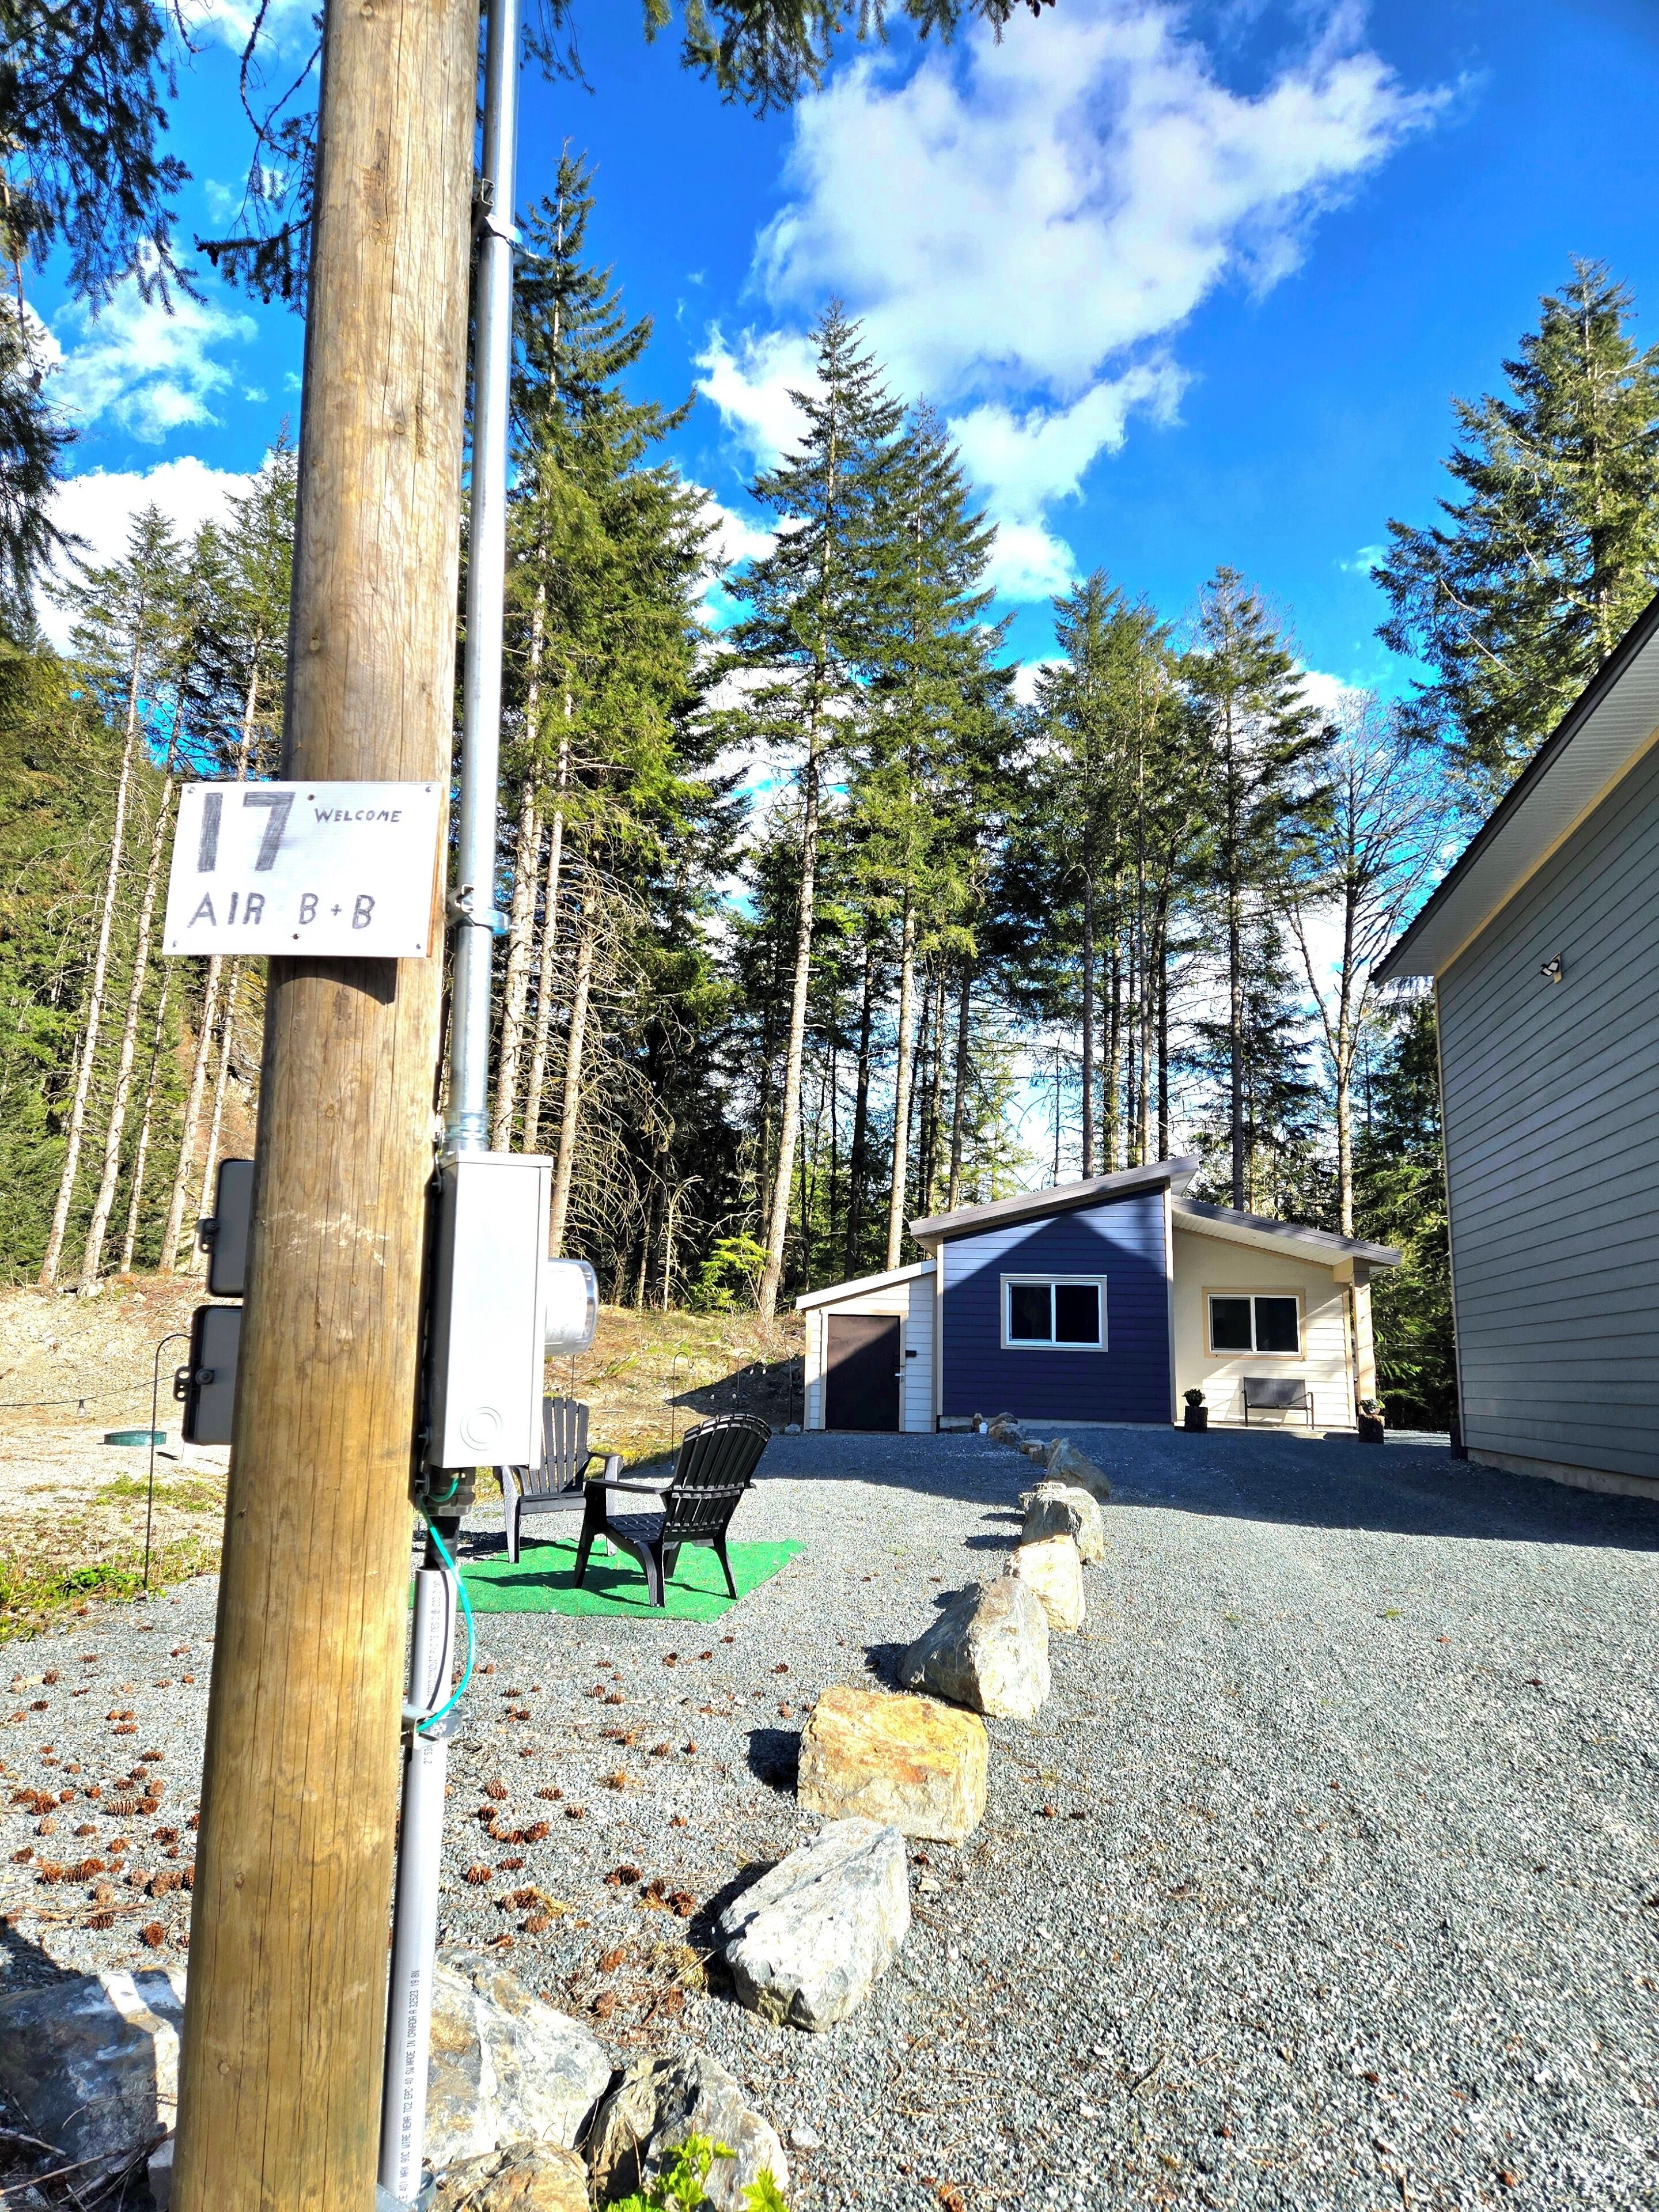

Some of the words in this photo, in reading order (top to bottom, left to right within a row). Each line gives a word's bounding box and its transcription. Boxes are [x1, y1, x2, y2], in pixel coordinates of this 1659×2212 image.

[315, 808, 402, 823] WELCOME
[196, 791, 296, 872] 17
[187, 892, 265, 928] AIR
[409, 1990, 419, 2008] 32523
[407, 2016, 417, 2038] CANADA
[407, 2040, 415, 2048] IN
[406, 2051, 415, 2066] MADE
[403, 2102, 412, 2113] TC2
[402, 2116, 411, 2131] NEMA
[402, 2134, 411, 2149] WIRE
[401, 2152, 410, 2162] 90C
[400, 2166, 409, 2177] MAX
